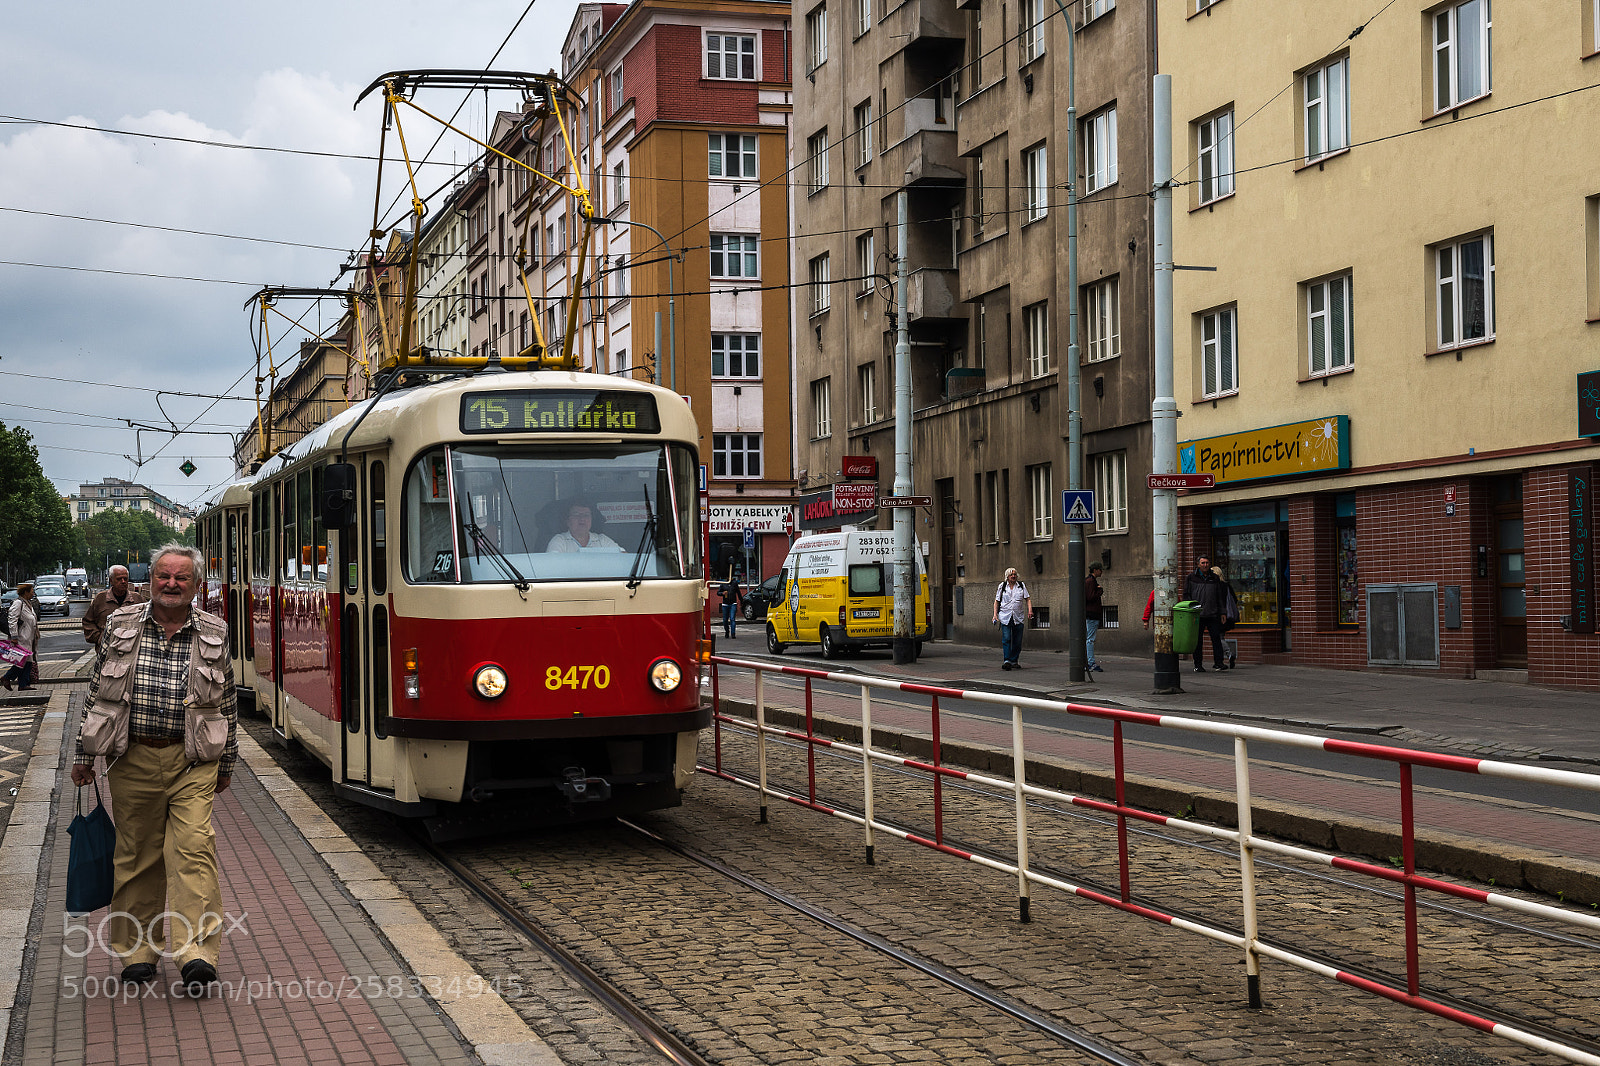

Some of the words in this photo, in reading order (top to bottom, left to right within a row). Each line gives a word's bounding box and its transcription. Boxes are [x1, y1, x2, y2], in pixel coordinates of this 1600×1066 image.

[470, 398, 509, 429] 15
[524, 400, 636, 429] Kotlářka
[1200, 431, 1301, 479] Papírnictví
[1150, 477, 1187, 487] Rečkova
[735, 508, 780, 517] KABELKY
[835, 498, 874, 509] NON-STOP
[1571, 476, 1588, 539] gallery
[747, 520, 772, 530] CENY
[858, 538, 873, 546] 283
[875, 537, 889, 546] 870
[434, 554, 452, 571] 216
[1572, 543, 1585, 583] cafe
[1576, 588, 1586, 624] mini
[545, 664, 611, 691] 8470
